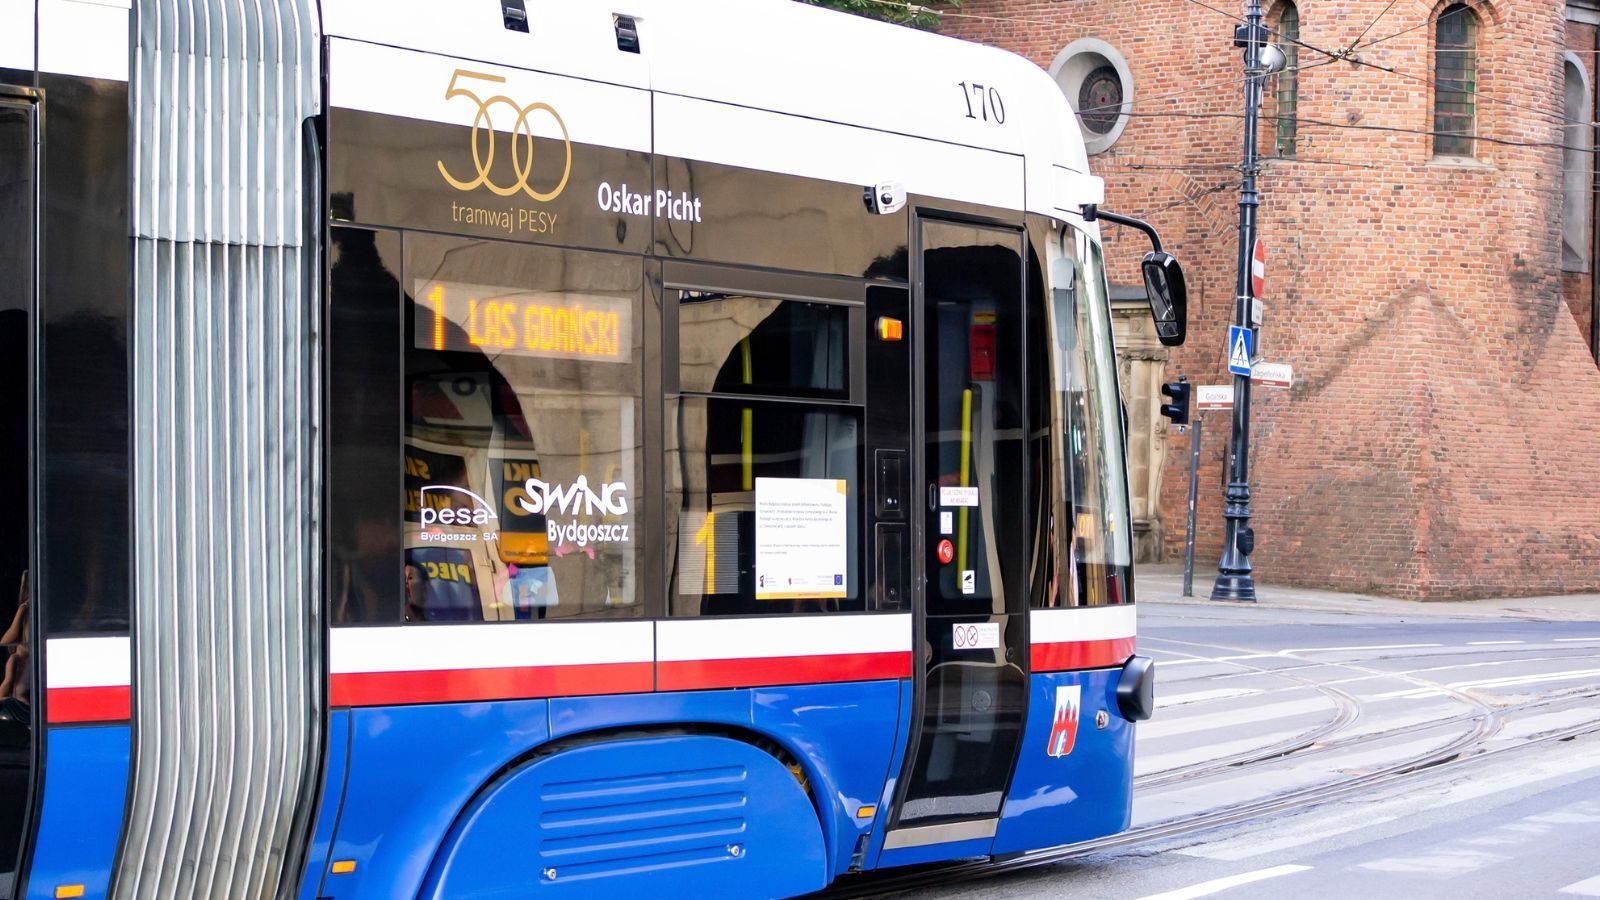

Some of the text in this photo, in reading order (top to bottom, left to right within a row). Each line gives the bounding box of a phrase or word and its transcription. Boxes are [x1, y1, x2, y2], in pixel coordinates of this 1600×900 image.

[958, 81, 1005, 125] 170
[437, 69, 572, 202] 500
[451, 200, 558, 235] tramwaj PESY
[597, 181, 702, 224] Oskar Picht
[427, 285, 619, 355] 1 LAS GDAŃSKI
[420, 508, 489, 528] pesa
[421, 532, 498, 541] Bydgoszcz SA
[547, 520, 629, 548] Bydgoszcz
[695, 512, 715, 594] 1
